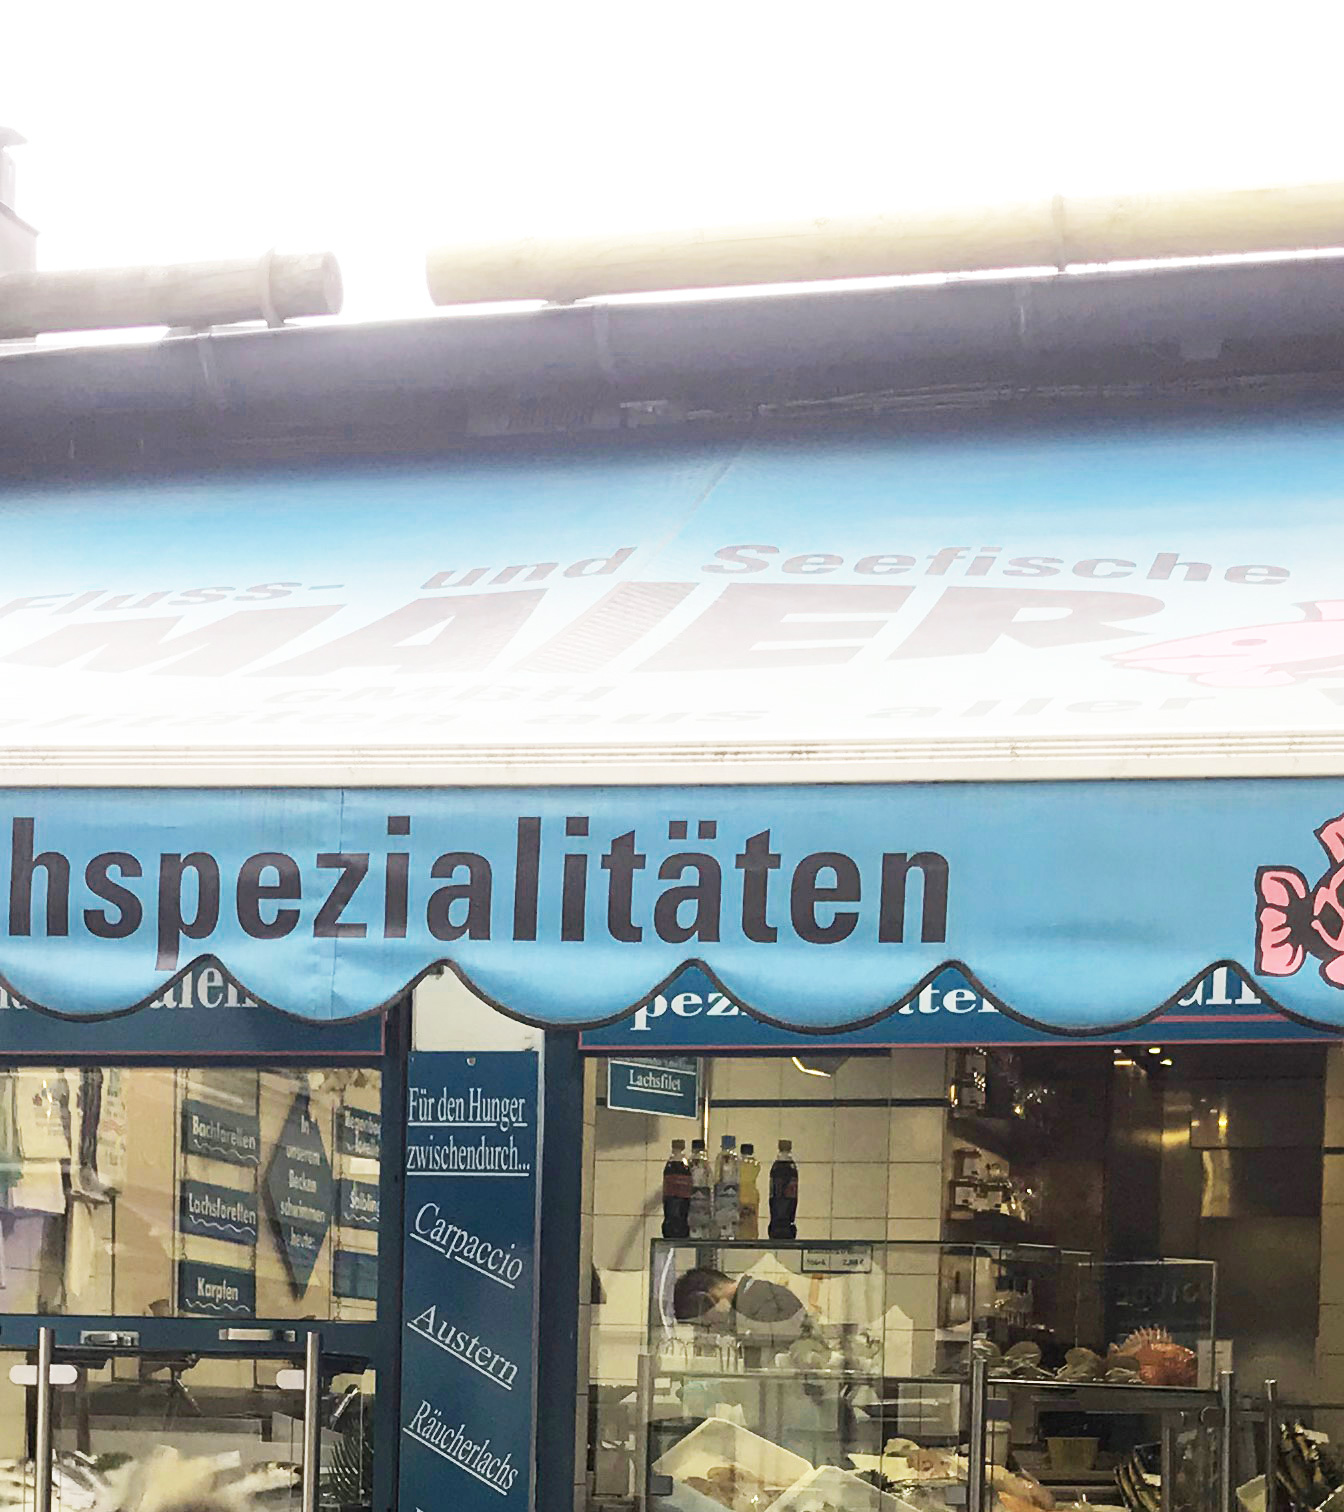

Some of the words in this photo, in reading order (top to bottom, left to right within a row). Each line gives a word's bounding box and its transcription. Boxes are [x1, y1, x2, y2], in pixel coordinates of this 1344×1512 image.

[420, 546, 638, 590] und
[699, 543, 1290, 587] Seefische
[629, 1069, 681, 1091] Lachsfilet
[408, 1087, 435, 1122] Für
[437, 1088, 464, 1122] den
[467, 1088, 526, 1132] Hunger
[407, 1135, 530, 1171] zwischendurch...
[414, 1202, 523, 1282] Carpaccio
[197, 1277, 239, 1302] Karpfen
[411, 1304, 520, 1386] Austern
[408, 1400, 519, 1491] Räucherlachs
